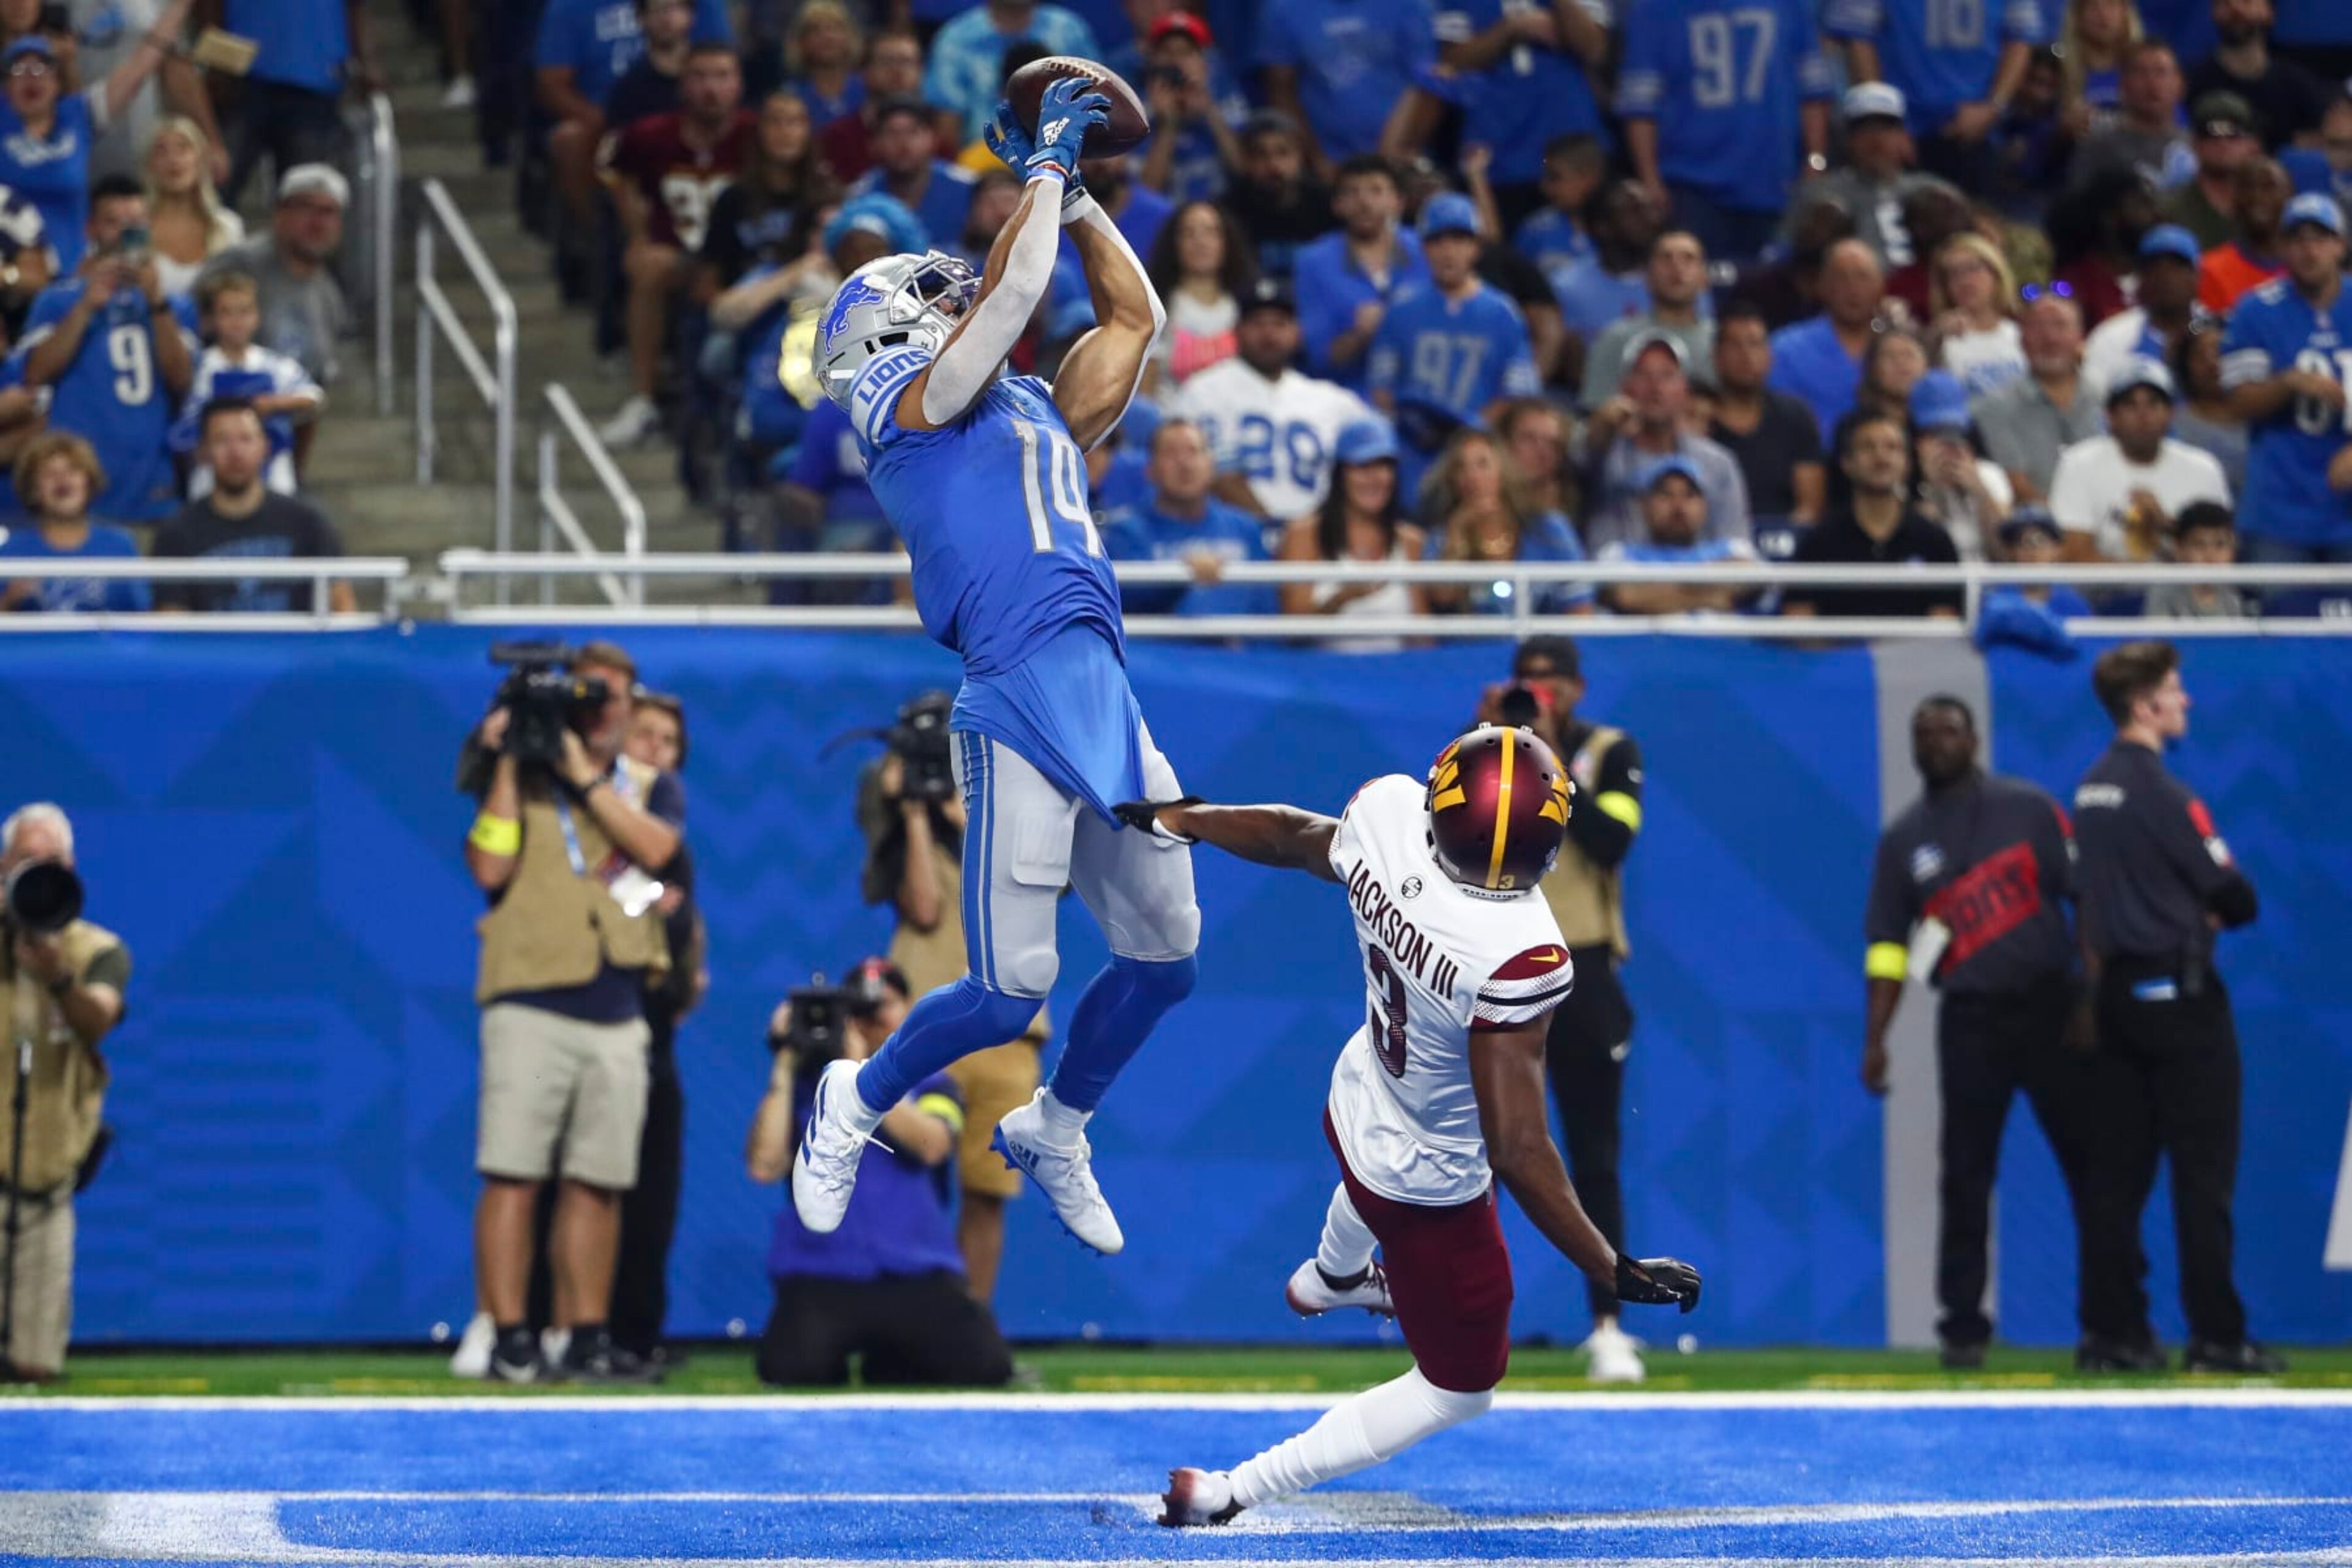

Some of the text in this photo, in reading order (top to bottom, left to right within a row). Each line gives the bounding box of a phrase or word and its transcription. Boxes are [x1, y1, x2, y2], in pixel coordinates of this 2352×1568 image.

[1687, 9, 1778, 107] 97
[108, 324, 154, 404] 9
[1414, 332, 1487, 412] 97
[1011, 419, 1102, 559] 14
[1348, 858, 1459, 1001] JACKSON III
[1499, 875, 1515, 889] 3
[1369, 943, 1408, 1079] 3
